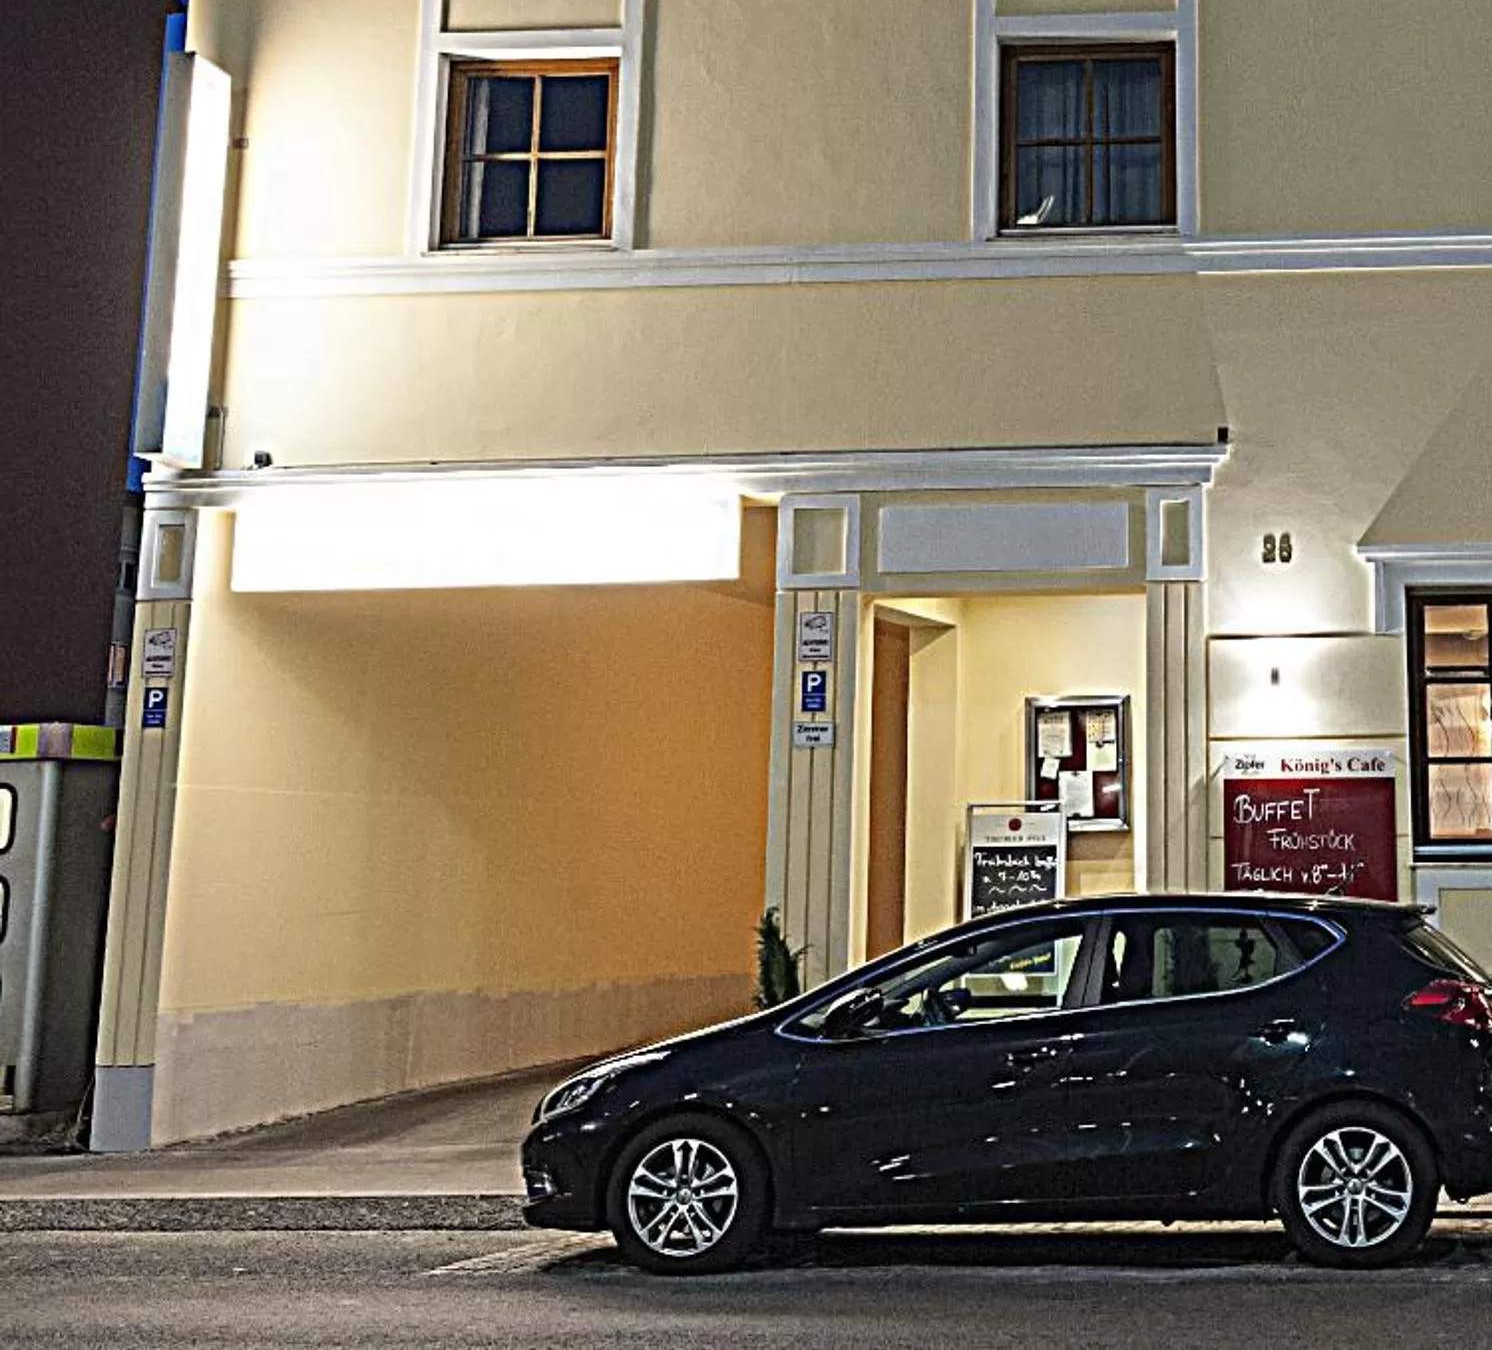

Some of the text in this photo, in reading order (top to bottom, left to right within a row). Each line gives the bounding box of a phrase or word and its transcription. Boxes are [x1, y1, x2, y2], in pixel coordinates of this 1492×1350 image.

[807, 673, 822, 693] P
[148, 690, 164, 708] P
[1280, 757, 1342, 774] König's
